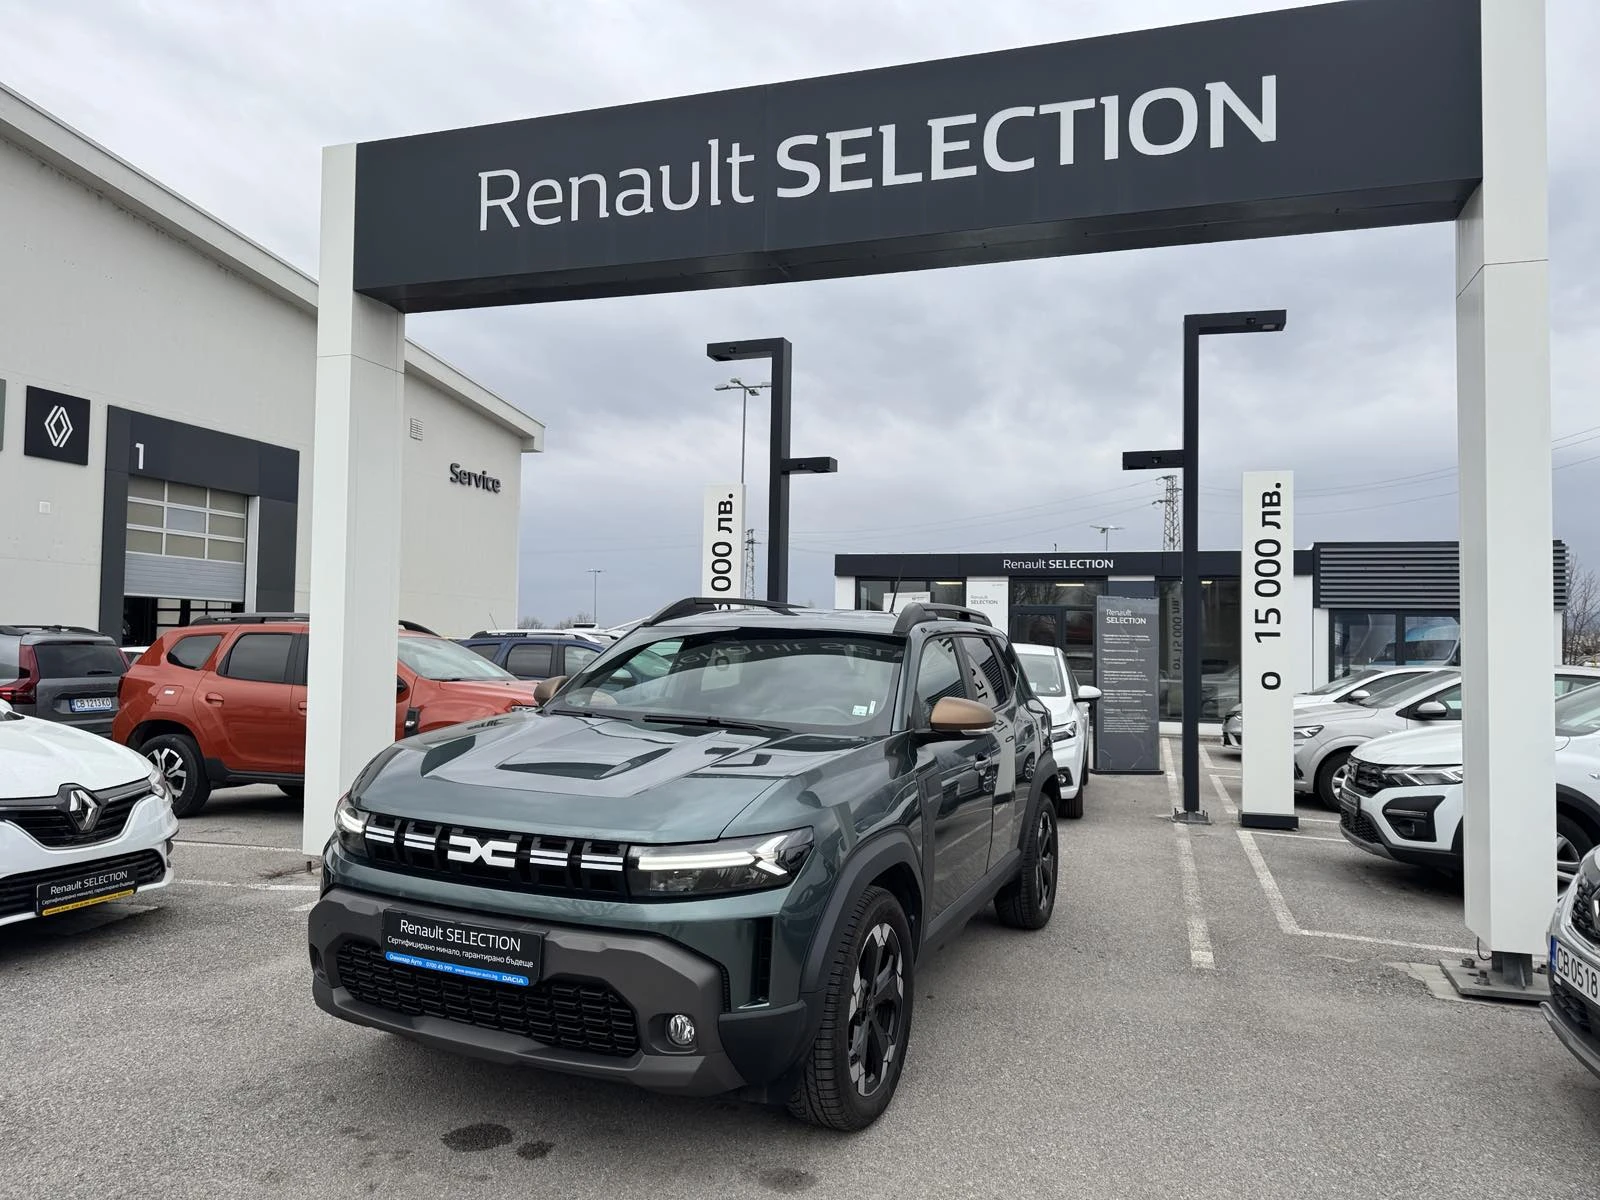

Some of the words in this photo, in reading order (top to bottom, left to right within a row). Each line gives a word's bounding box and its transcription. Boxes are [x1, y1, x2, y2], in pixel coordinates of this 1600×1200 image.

[478, 138, 755, 232] Renault
[776, 74, 1278, 199] SELECTION
[135, 442, 144, 470] 1
[449, 462, 501, 494] Service
[717, 493, 734, 534] лв.
[1261, 482, 1281, 529] лв.
[711, 541, 732, 592] 000
[1003, 558, 1047, 569] Renault
[1048, 558, 1114, 569] SELECTION
[1254, 538, 1281, 598] 000
[1106, 608, 1132, 617] Renault
[1254, 608, 1281, 643] 15
[50, 881, 82, 895] Renault
[83, 870, 128, 888] SELECTION
[387, 935, 435, 951] Сертифицирано
[436, 946, 461, 957] минало,
[462, 950, 505, 963] гарантирано
[506, 956, 534, 968] бъдеще
[400, 919, 444, 940] Renault
[446, 928, 521, 952] SELECTION
[502, 975, 524, 984] DACIA
